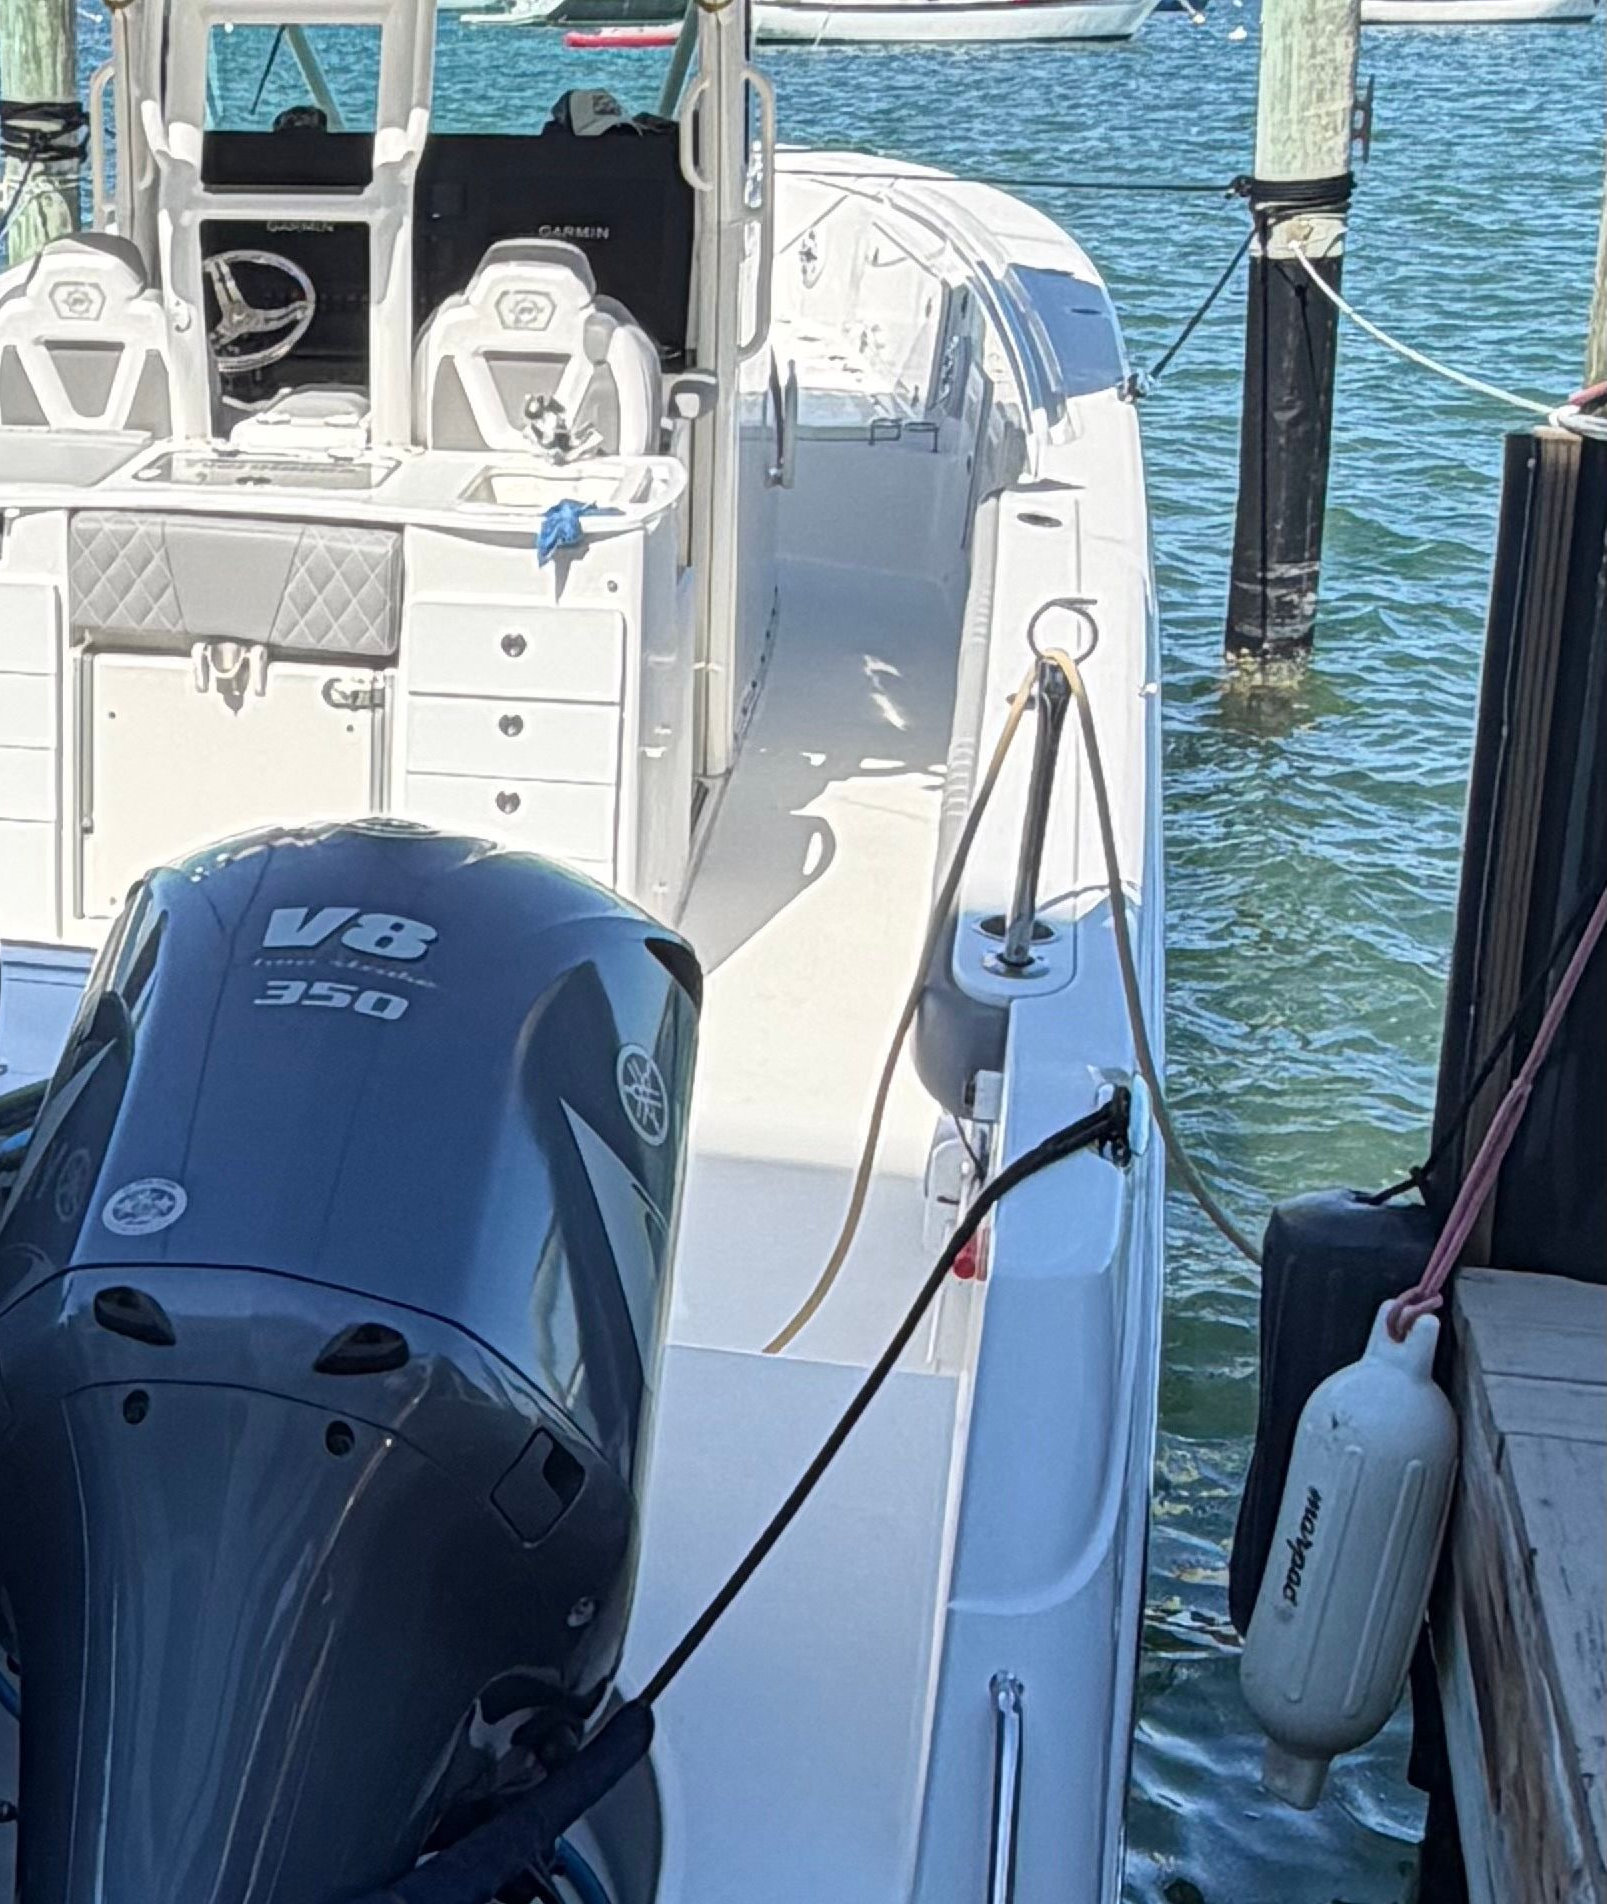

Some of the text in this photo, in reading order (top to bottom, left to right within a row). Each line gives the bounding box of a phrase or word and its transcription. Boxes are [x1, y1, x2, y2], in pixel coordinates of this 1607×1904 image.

[538, 224, 610, 239] GARMIN
[262, 906, 439, 960] V8
[253, 980, 410, 1021] 350
